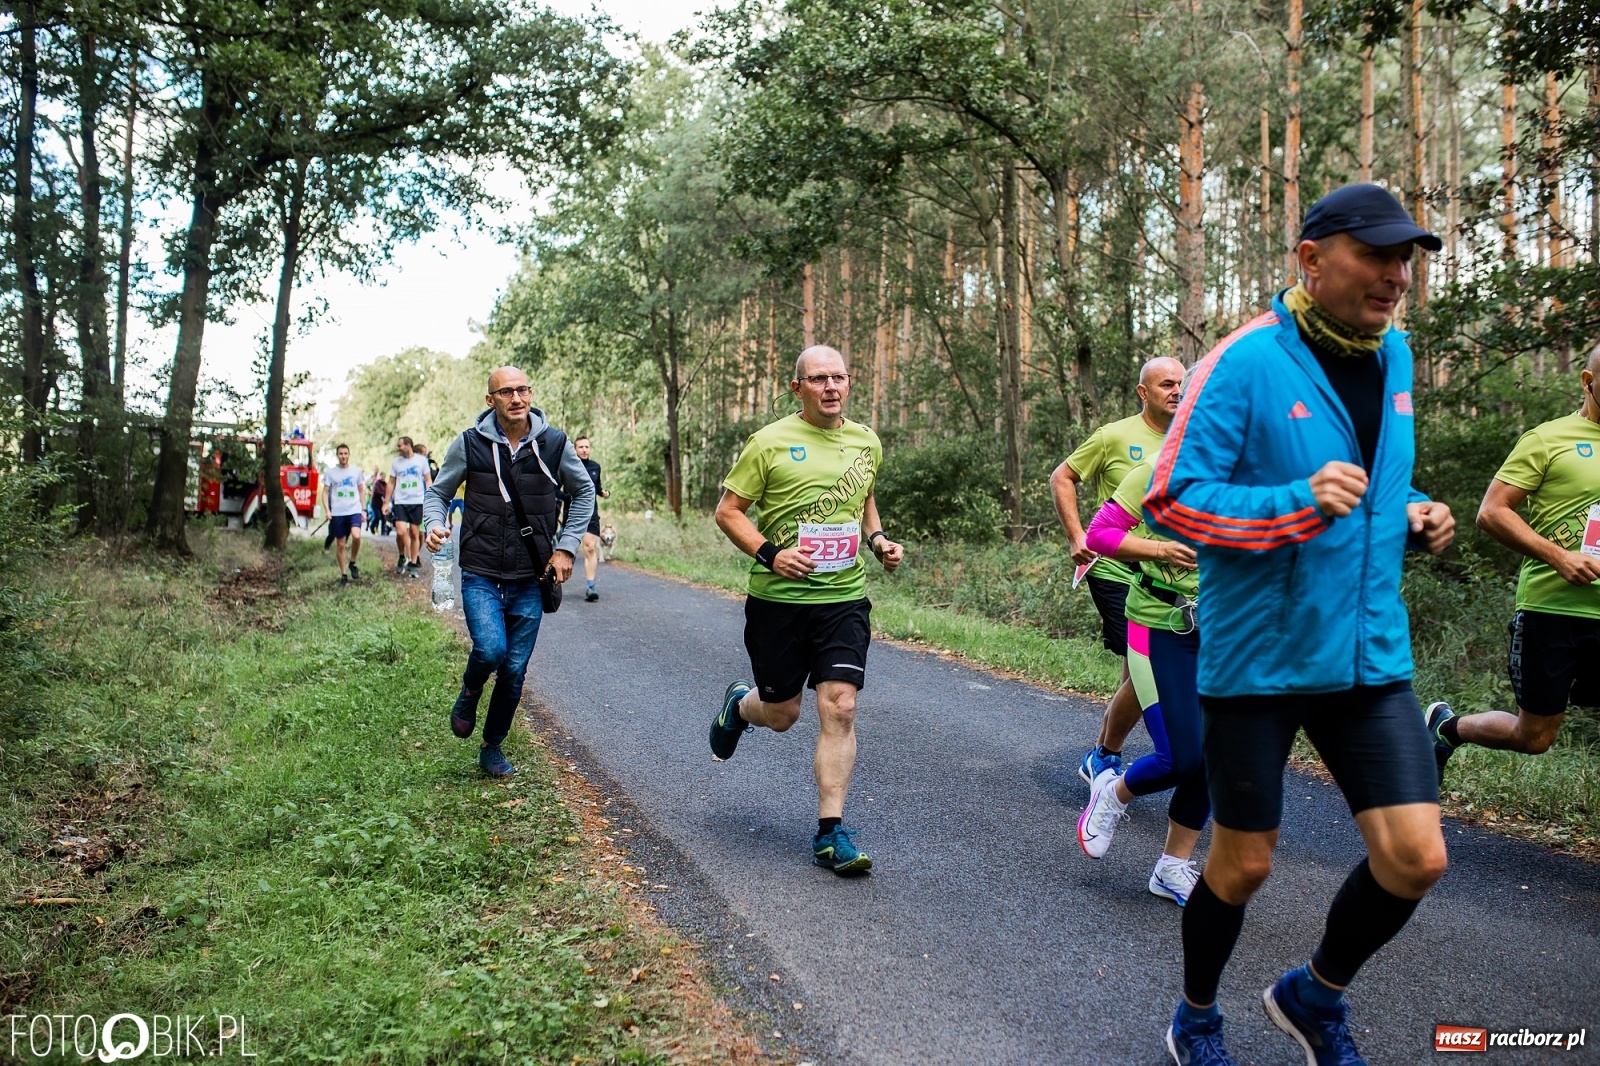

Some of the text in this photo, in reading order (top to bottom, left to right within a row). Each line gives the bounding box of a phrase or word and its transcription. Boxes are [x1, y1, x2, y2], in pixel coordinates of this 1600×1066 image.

[294, 489, 311, 500] OSP
[810, 538, 851, 560] 232
[1510, 611, 1525, 680] UNDER
